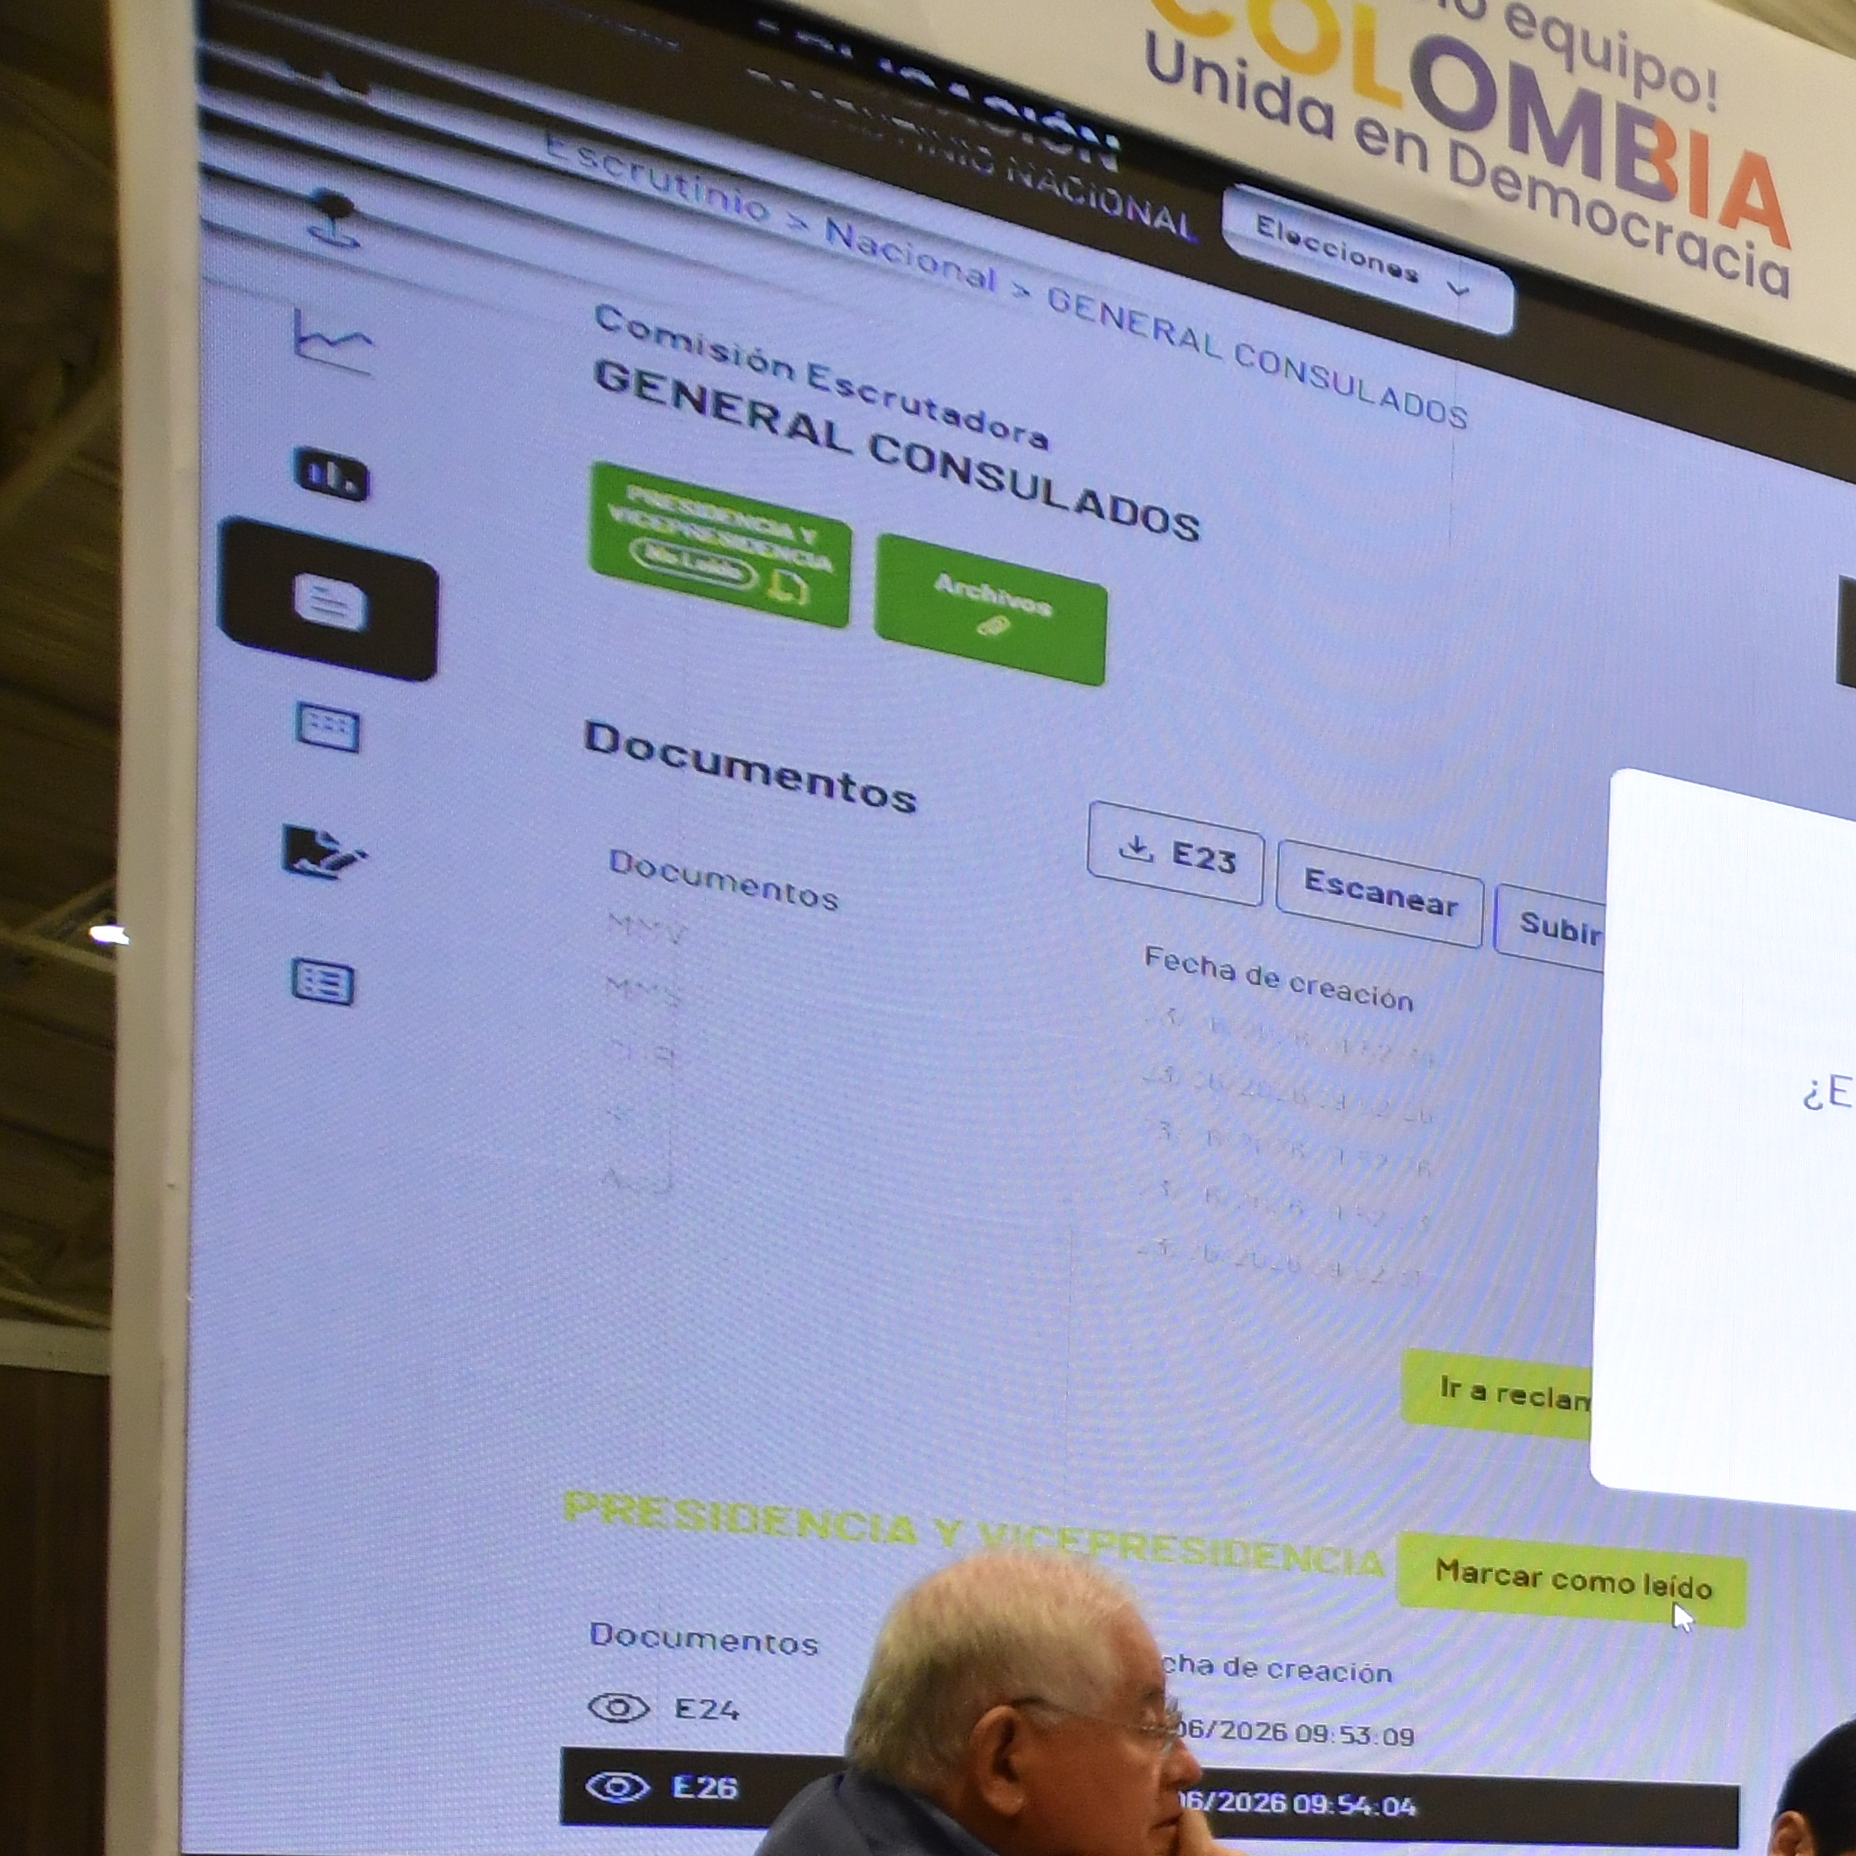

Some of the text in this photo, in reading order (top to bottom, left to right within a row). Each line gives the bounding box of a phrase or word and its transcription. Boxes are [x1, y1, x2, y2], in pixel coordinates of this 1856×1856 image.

[1504, 2, 1718, 112] equipo!
[1145, 29, 1335, 140] Unida
[1355, 114, 1429, 174] en
[1450, 138, 1792, 300] Democracia
[546, 130, 771, 224] Escrutinio
[825, 216, 997, 292] Nacional
[1048, 286, 1224, 361] GENERAL
[1235, 341, 1470, 431] CONSULADOS
[1256, 214, 1420, 285] Elecciones
[595, 303, 1050, 452] Comisión Escrutadora
[594, 358, 1201, 543] GENERAL CONSULADOS
[934, 572, 1053, 619] Archivos
[583, 719, 919, 817] Documentos
[608, 848, 840, 914] Documentos
[1172, 840, 1604, 946] E23 Escanear Subir
[1144, 945, 1414, 1013] Fecha de creación
[1440, 1373, 1462, 1399] Ir
[1470, 1383, 1487, 1402] a
[564, 1490, 1387, 1578] PRESIDENCIA Y VICEPRESIDENCIA
[1435, 1556, 1714, 1603] Marcar como leído
[590, 1621, 820, 1656] Documentos
[1162, 1653, 1394, 1685] cha de creación
[674, 1700, 741, 1723] E24
[1178, 1719, 1416, 1748] 06/2026 09:53:09
[672, 1774, 741, 1802] E26
[1294, 1793, 1417, 1818] 09:54:04
